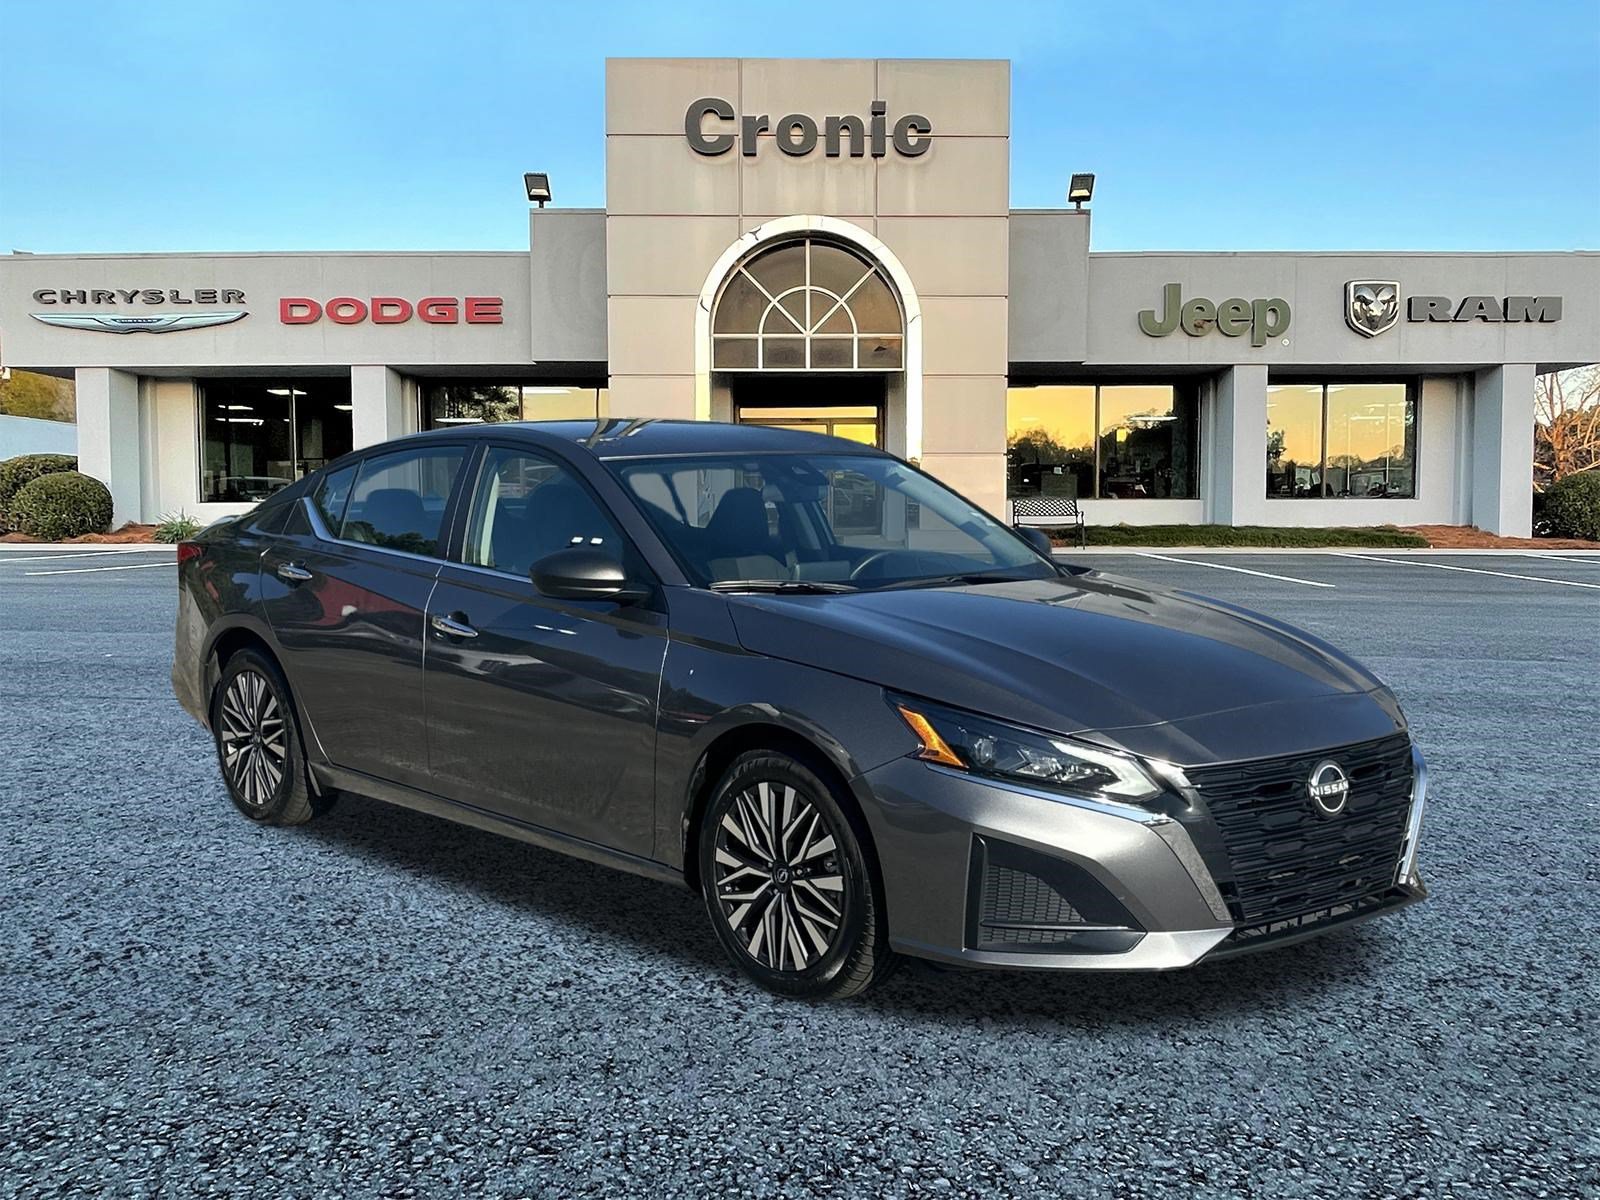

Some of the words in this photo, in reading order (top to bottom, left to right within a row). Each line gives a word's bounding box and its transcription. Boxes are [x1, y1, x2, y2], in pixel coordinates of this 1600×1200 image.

[685, 97, 932, 157] Cronic
[32, 288, 246, 304] CHRYSLER
[1407, 296, 1563, 322] RAM
[280, 297, 503, 324] DODGE
[1138, 283, 1291, 347] Jeep
[1310, 780, 1349, 797] NISSAN
